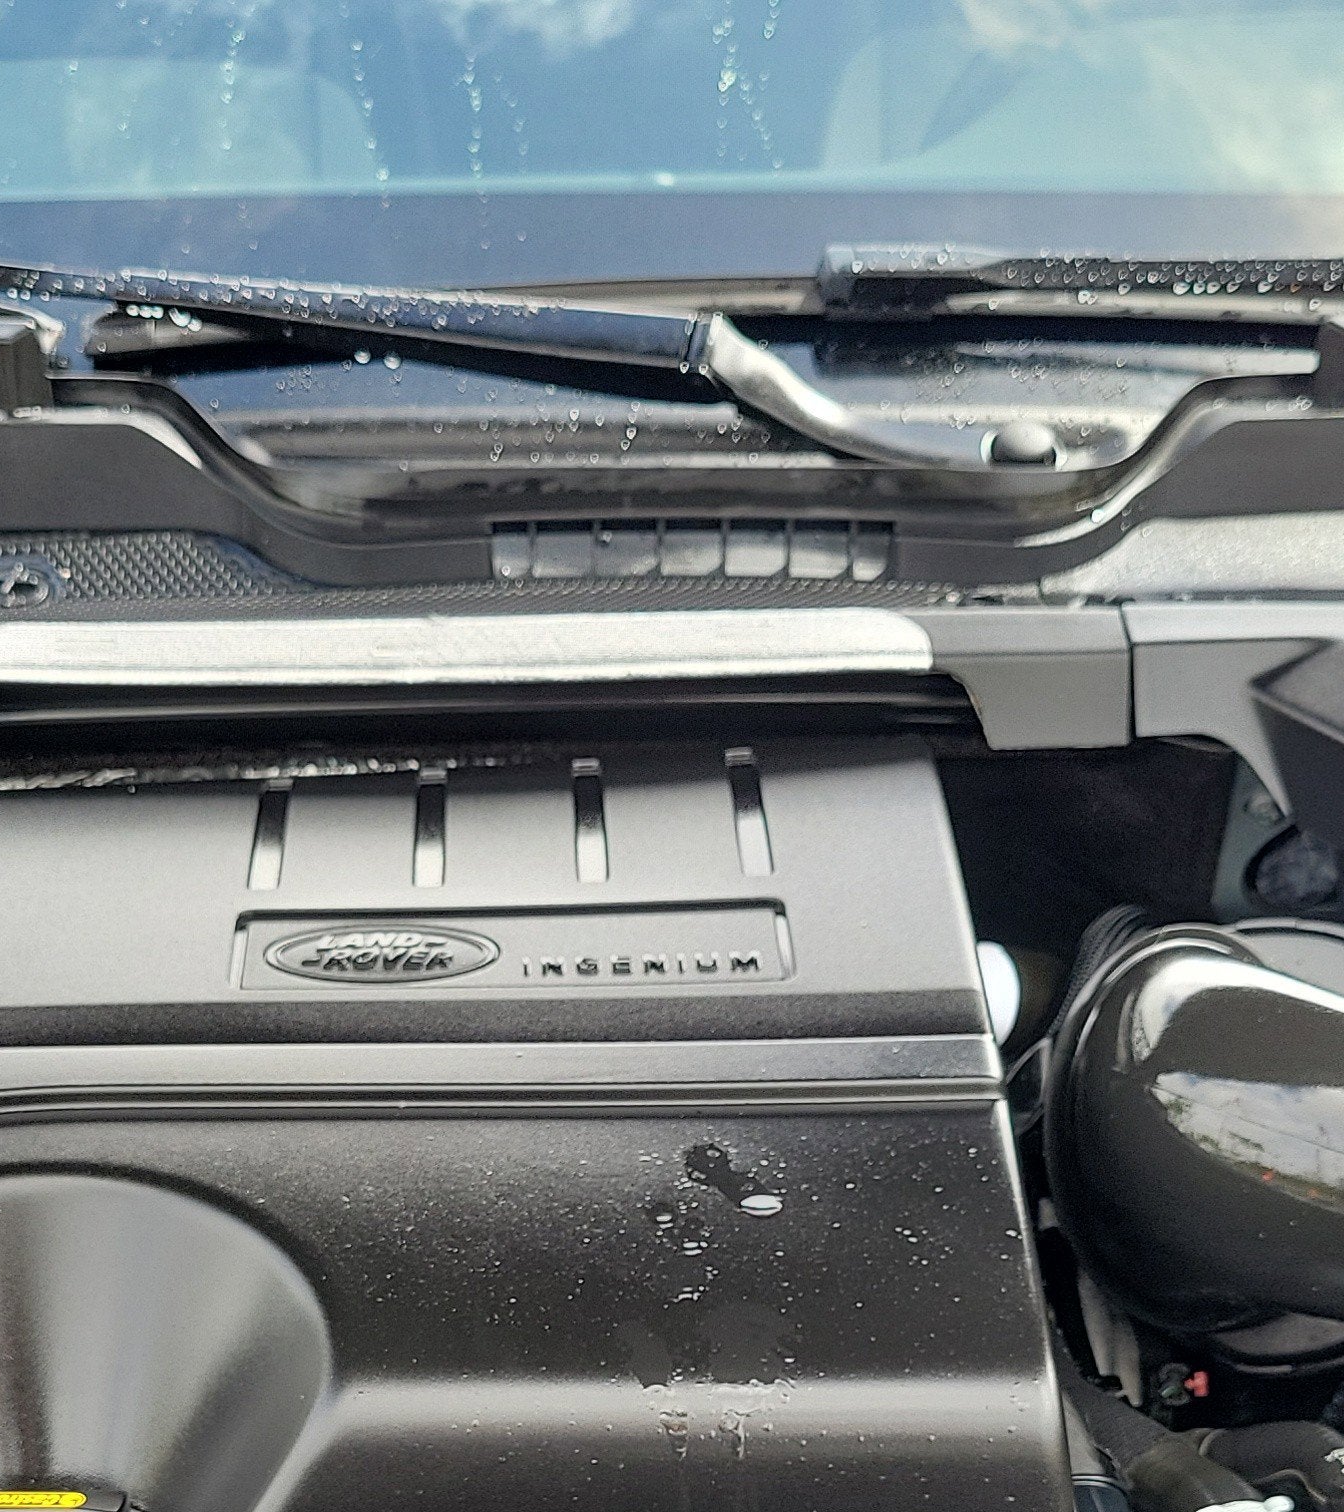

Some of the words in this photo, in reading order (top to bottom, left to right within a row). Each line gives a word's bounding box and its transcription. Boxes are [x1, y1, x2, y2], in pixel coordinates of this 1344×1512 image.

[316, 932, 424, 950] LAND
[322, 948, 454, 972] ROVER
[521, 950, 761, 977] INGENIUM
